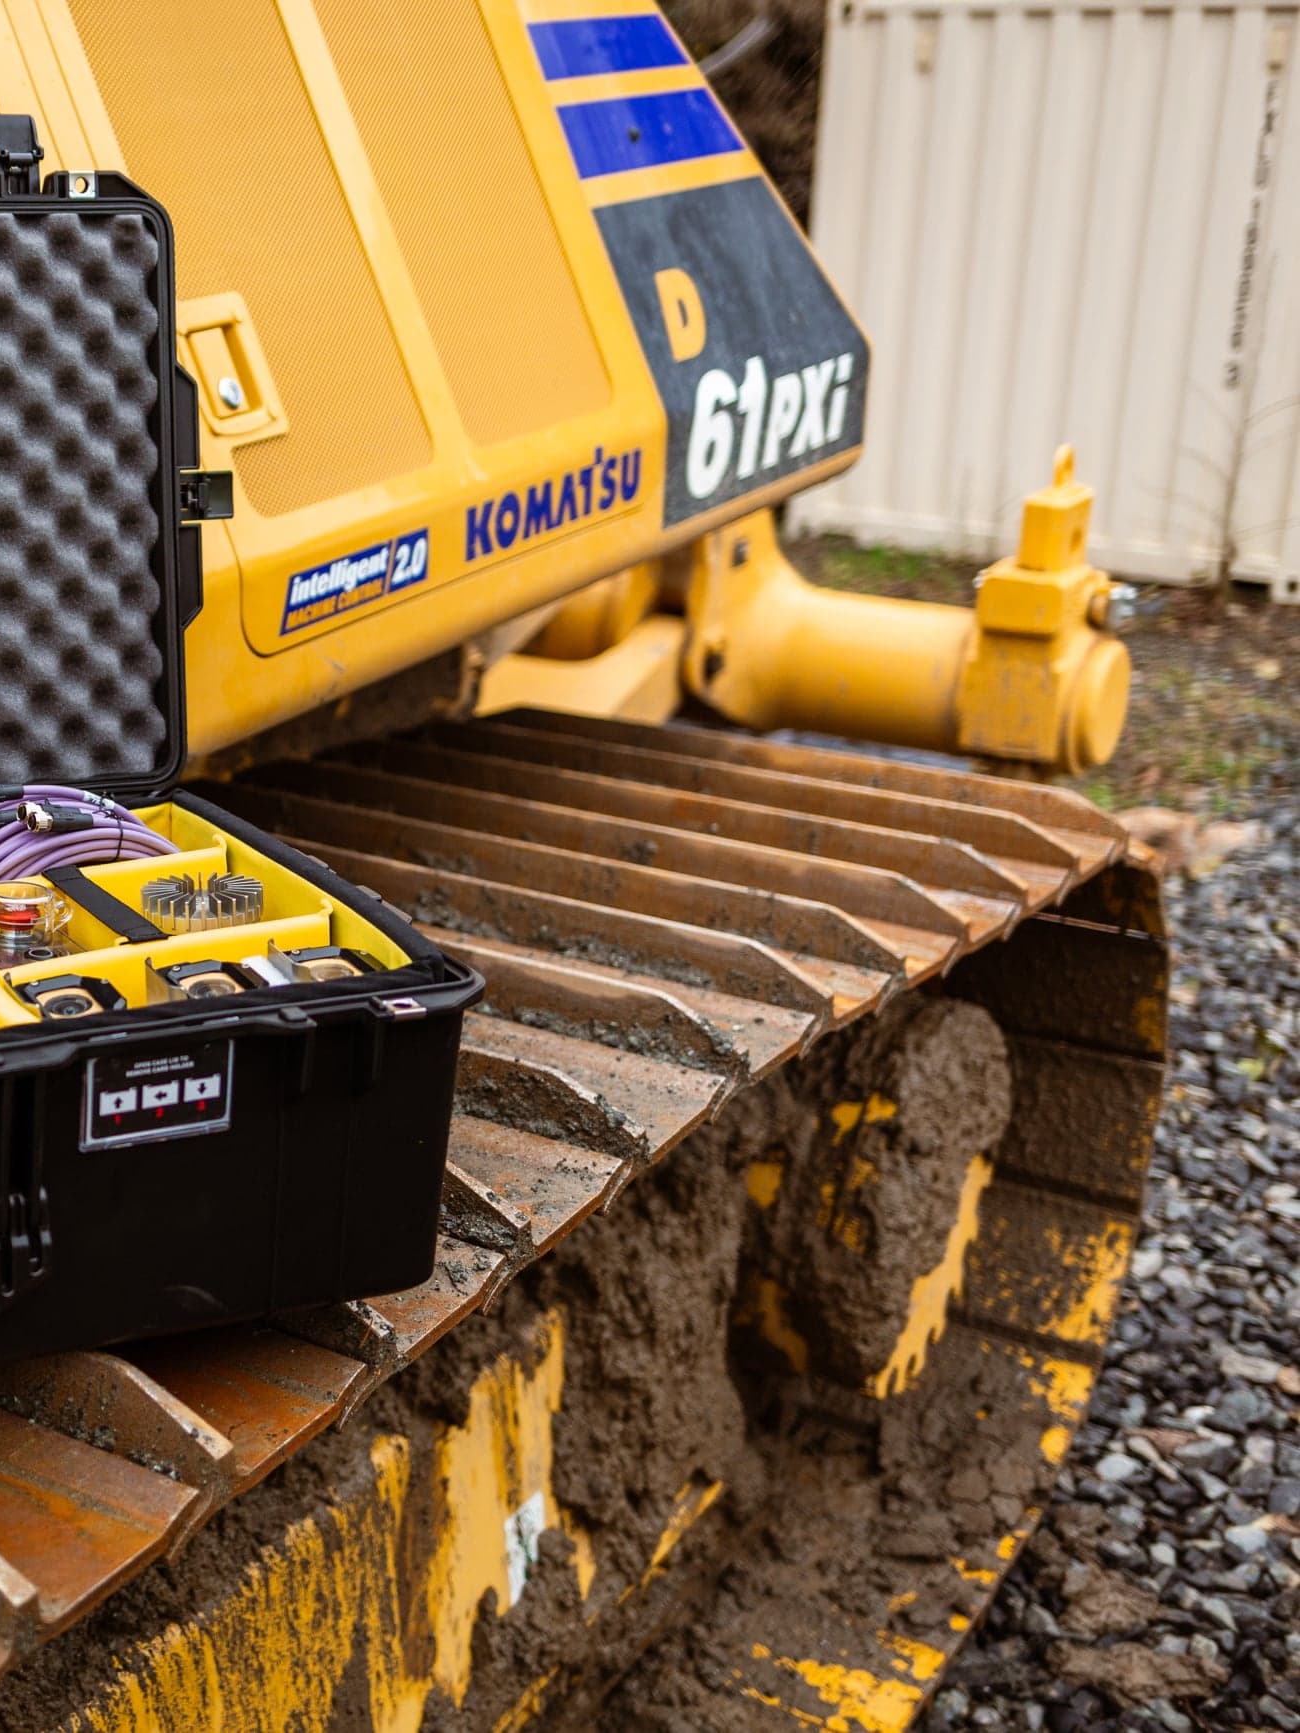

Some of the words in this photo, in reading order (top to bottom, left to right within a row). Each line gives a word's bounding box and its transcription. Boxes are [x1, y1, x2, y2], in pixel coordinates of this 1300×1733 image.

[654, 268, 707, 363] D
[686, 352, 854, 499] 61PXi
[466, 446, 641, 563] KOMATSU
[289, 546, 390, 606] intelligent
[391, 537, 428, 584] 2.0
[134, 1061, 151, 1069] OPEN
